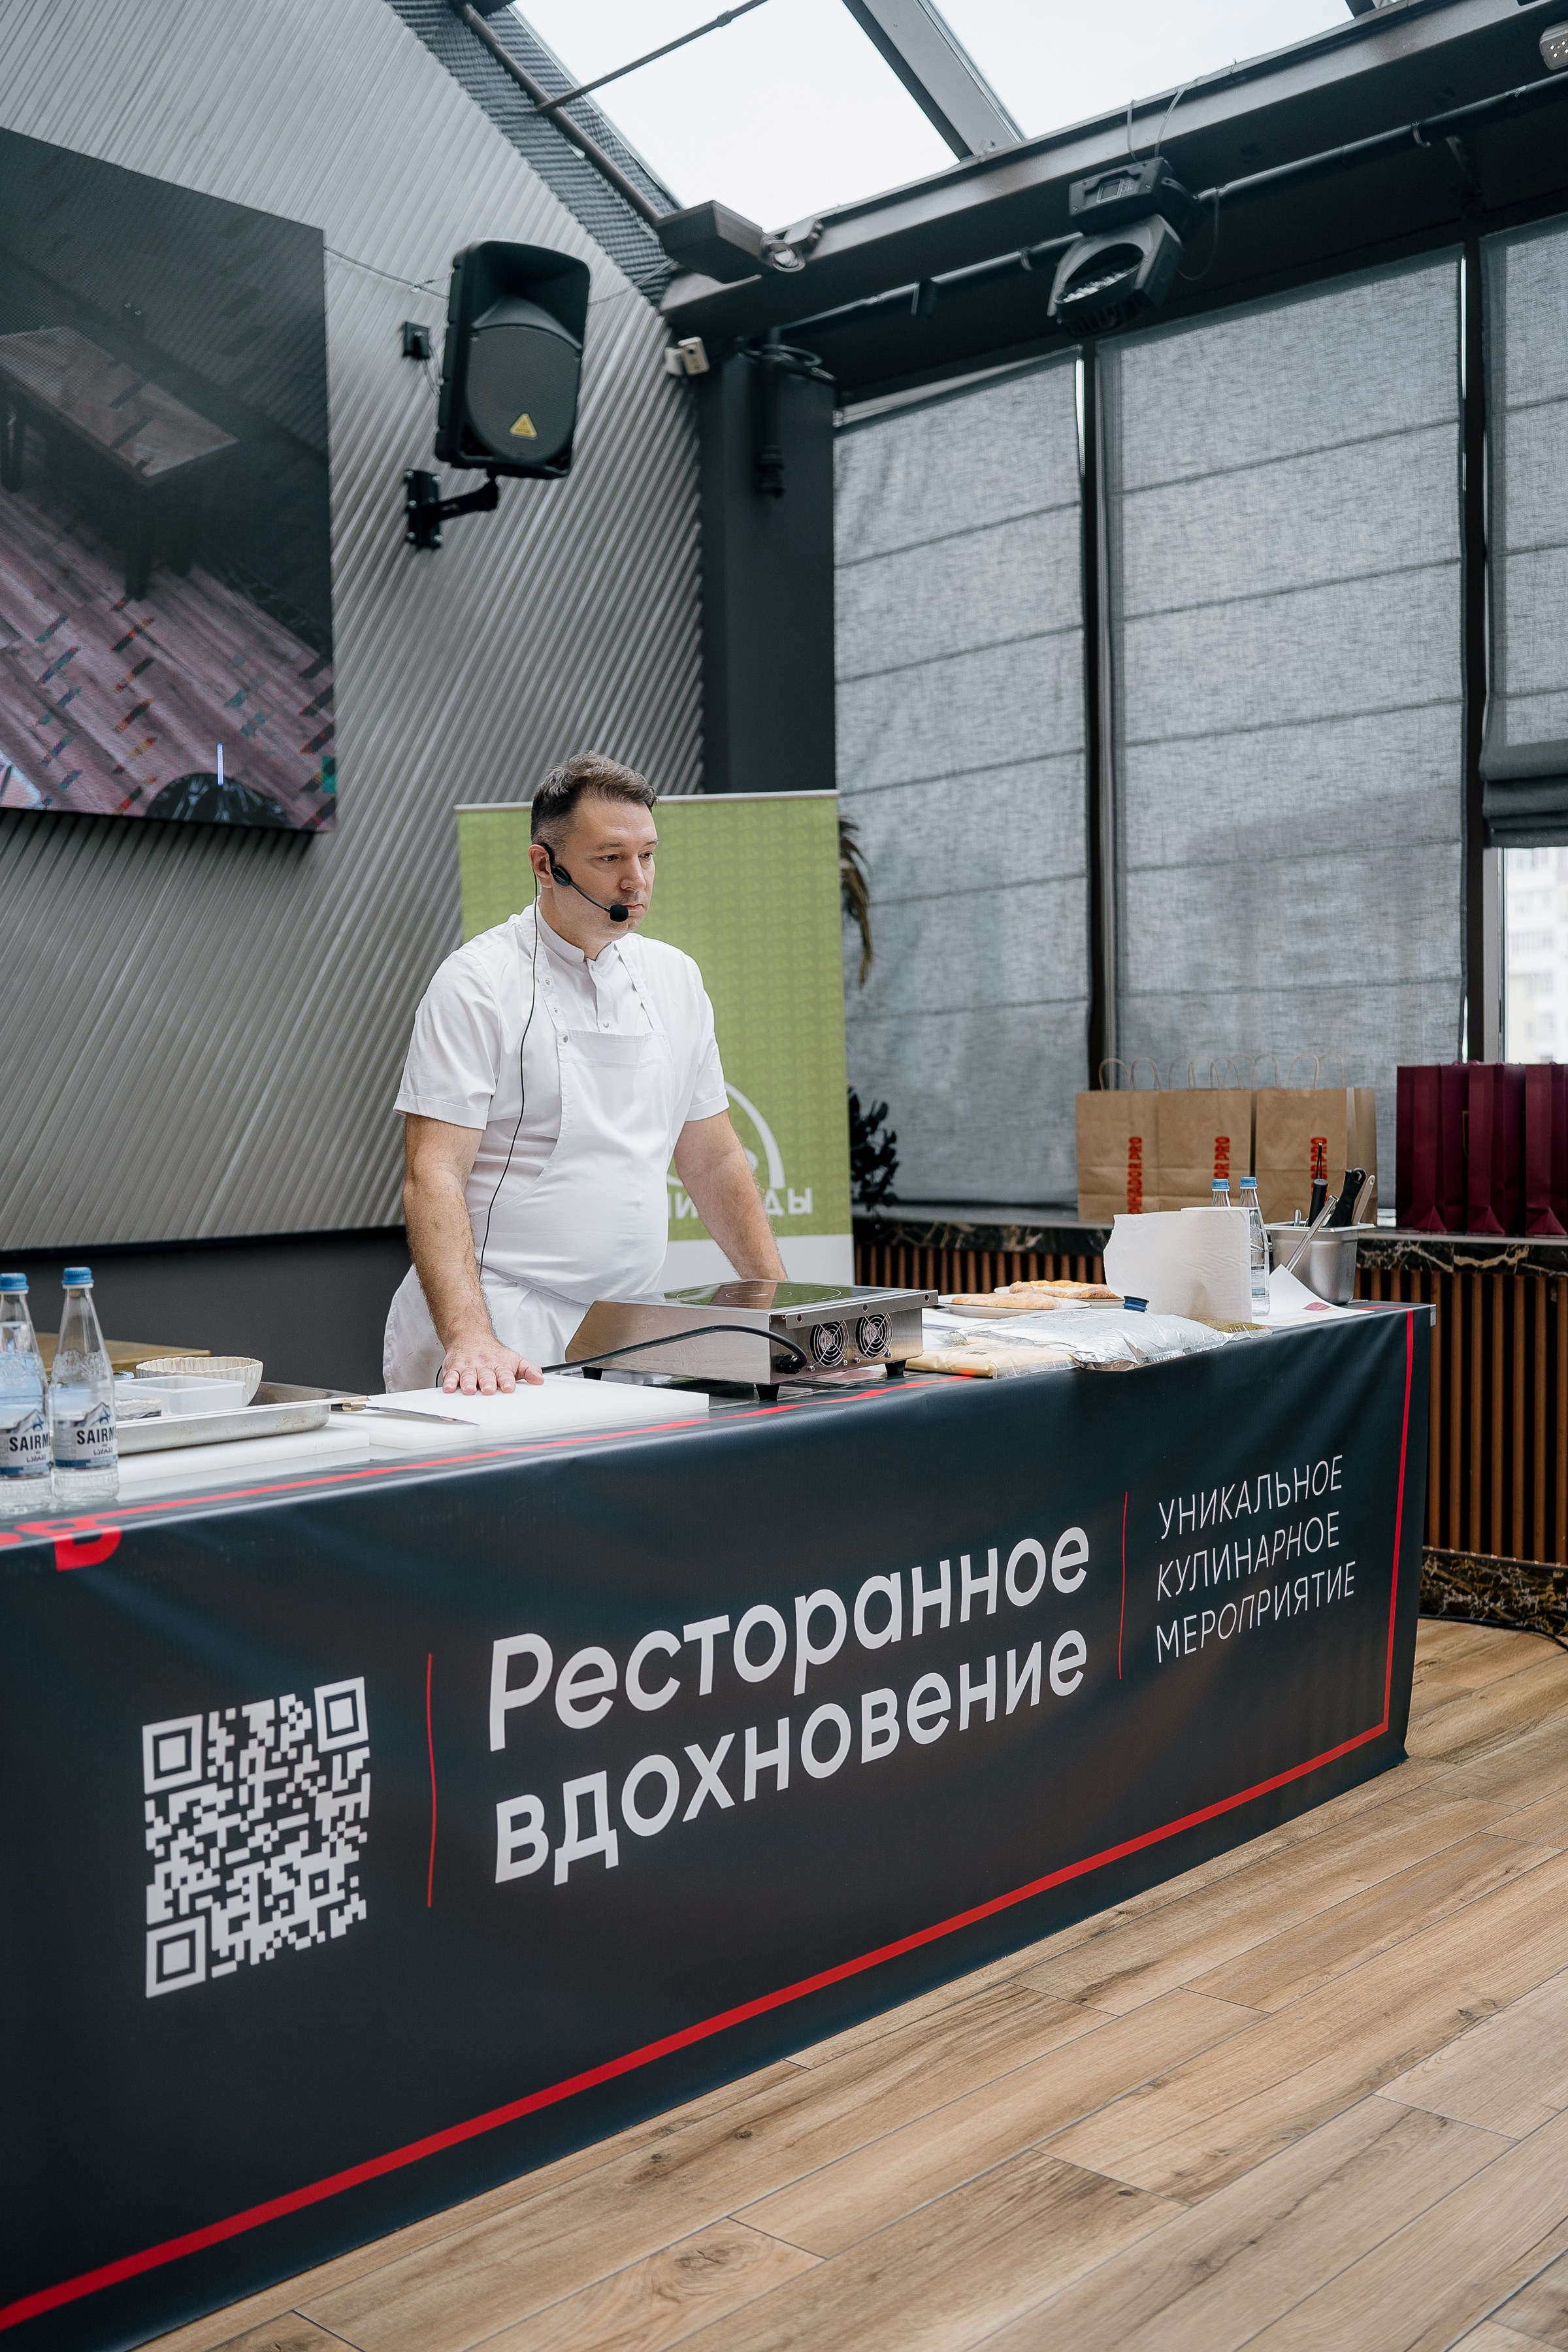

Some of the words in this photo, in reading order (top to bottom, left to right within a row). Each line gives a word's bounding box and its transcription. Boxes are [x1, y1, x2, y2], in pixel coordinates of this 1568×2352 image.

[1214, 1136, 1231, 1160] PRO
[1158, 1454, 1343, 1539] УНИКАЛЬНОЕ
[1157, 1511, 1339, 1601] КУЛИНАРНОЕ
[489, 1527, 1089, 1752] Ресторанное
[1156, 1560, 1356, 1663] МЕРОПРИЯТИЕ
[495, 1629, 1087, 1886] вдохновение
